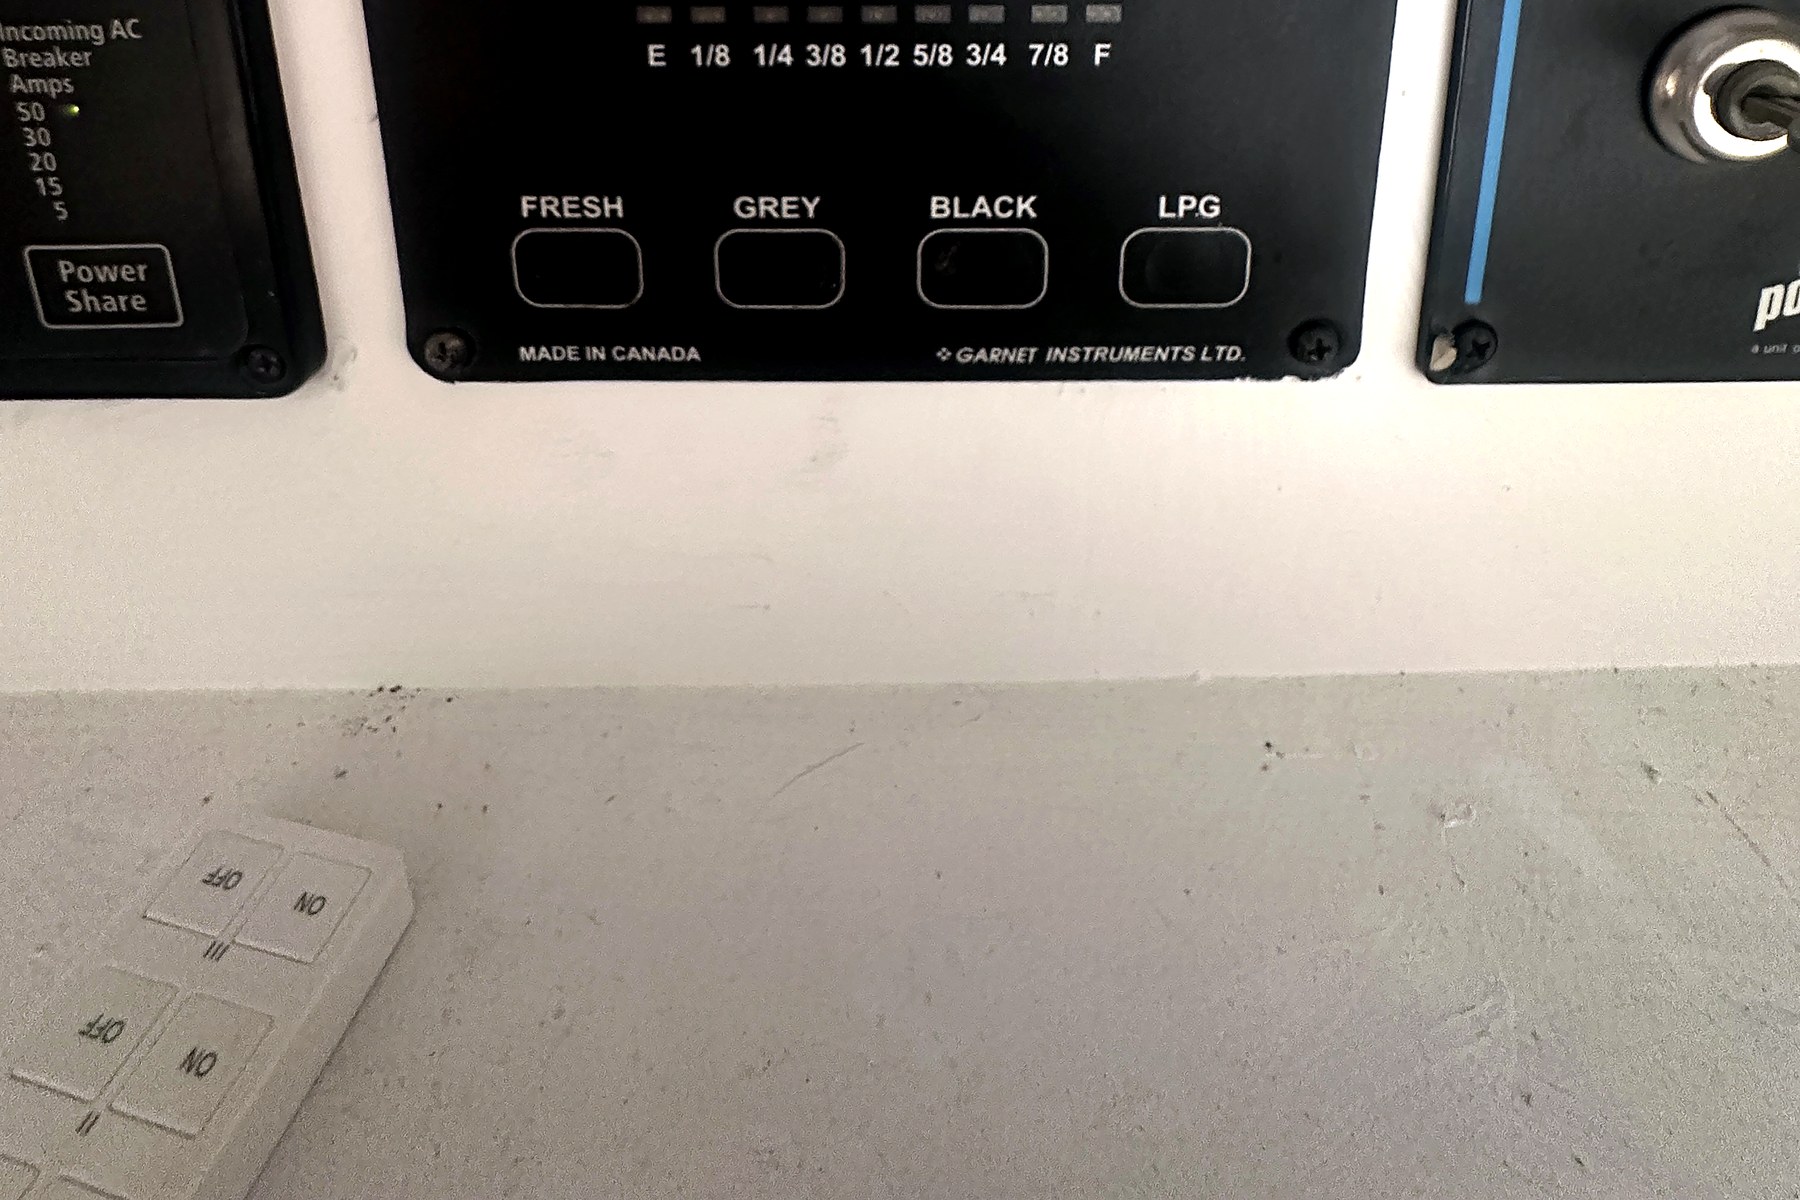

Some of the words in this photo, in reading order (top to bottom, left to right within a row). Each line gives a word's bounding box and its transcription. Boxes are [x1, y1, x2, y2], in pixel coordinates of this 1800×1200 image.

[0, 19, 105, 46] Incoming
[111, 18, 143, 40] AC
[2, 45, 92, 68] Breaker
[647, 44, 667, 67] E
[691, 43, 731, 67] 1/8
[754, 43, 794, 67] 1/4
[806, 43, 847, 67] 3/8
[860, 43, 900, 67] 1/2
[913, 43, 954, 67] 5/8
[966, 43, 1008, 67] 3/4
[1028, 43, 1069, 67] 7/8
[1094, 43, 1112, 67] F
[10, 74, 75, 99] Amps
[16, 101, 45, 122] 50
[22, 127, 51, 147] 30
[29, 152, 57, 172] 20
[35, 176, 63, 196] 15
[54, 201, 69, 220] 5
[521, 195, 624, 219] FRESH
[734, 196, 821, 219] GREY
[930, 195, 1037, 219] BLACK
[1158, 194, 1222, 219] LPG
[58, 260, 148, 283] Power
[66, 289, 147, 312] Share
[519, 345, 581, 362] MADE
[585, 346, 607, 362] IN
[612, 345, 702, 362] CANADA
[956, 346, 1038, 364] GARNET
[1045, 345, 1196, 363] INSTRUMENTS
[1200, 345, 1246, 362] LTD.
[202, 866, 244, 890] OFF
[293, 891, 327, 915] ON
[78, 1014, 127, 1044] OFF
[179, 1047, 219, 1077] ON
